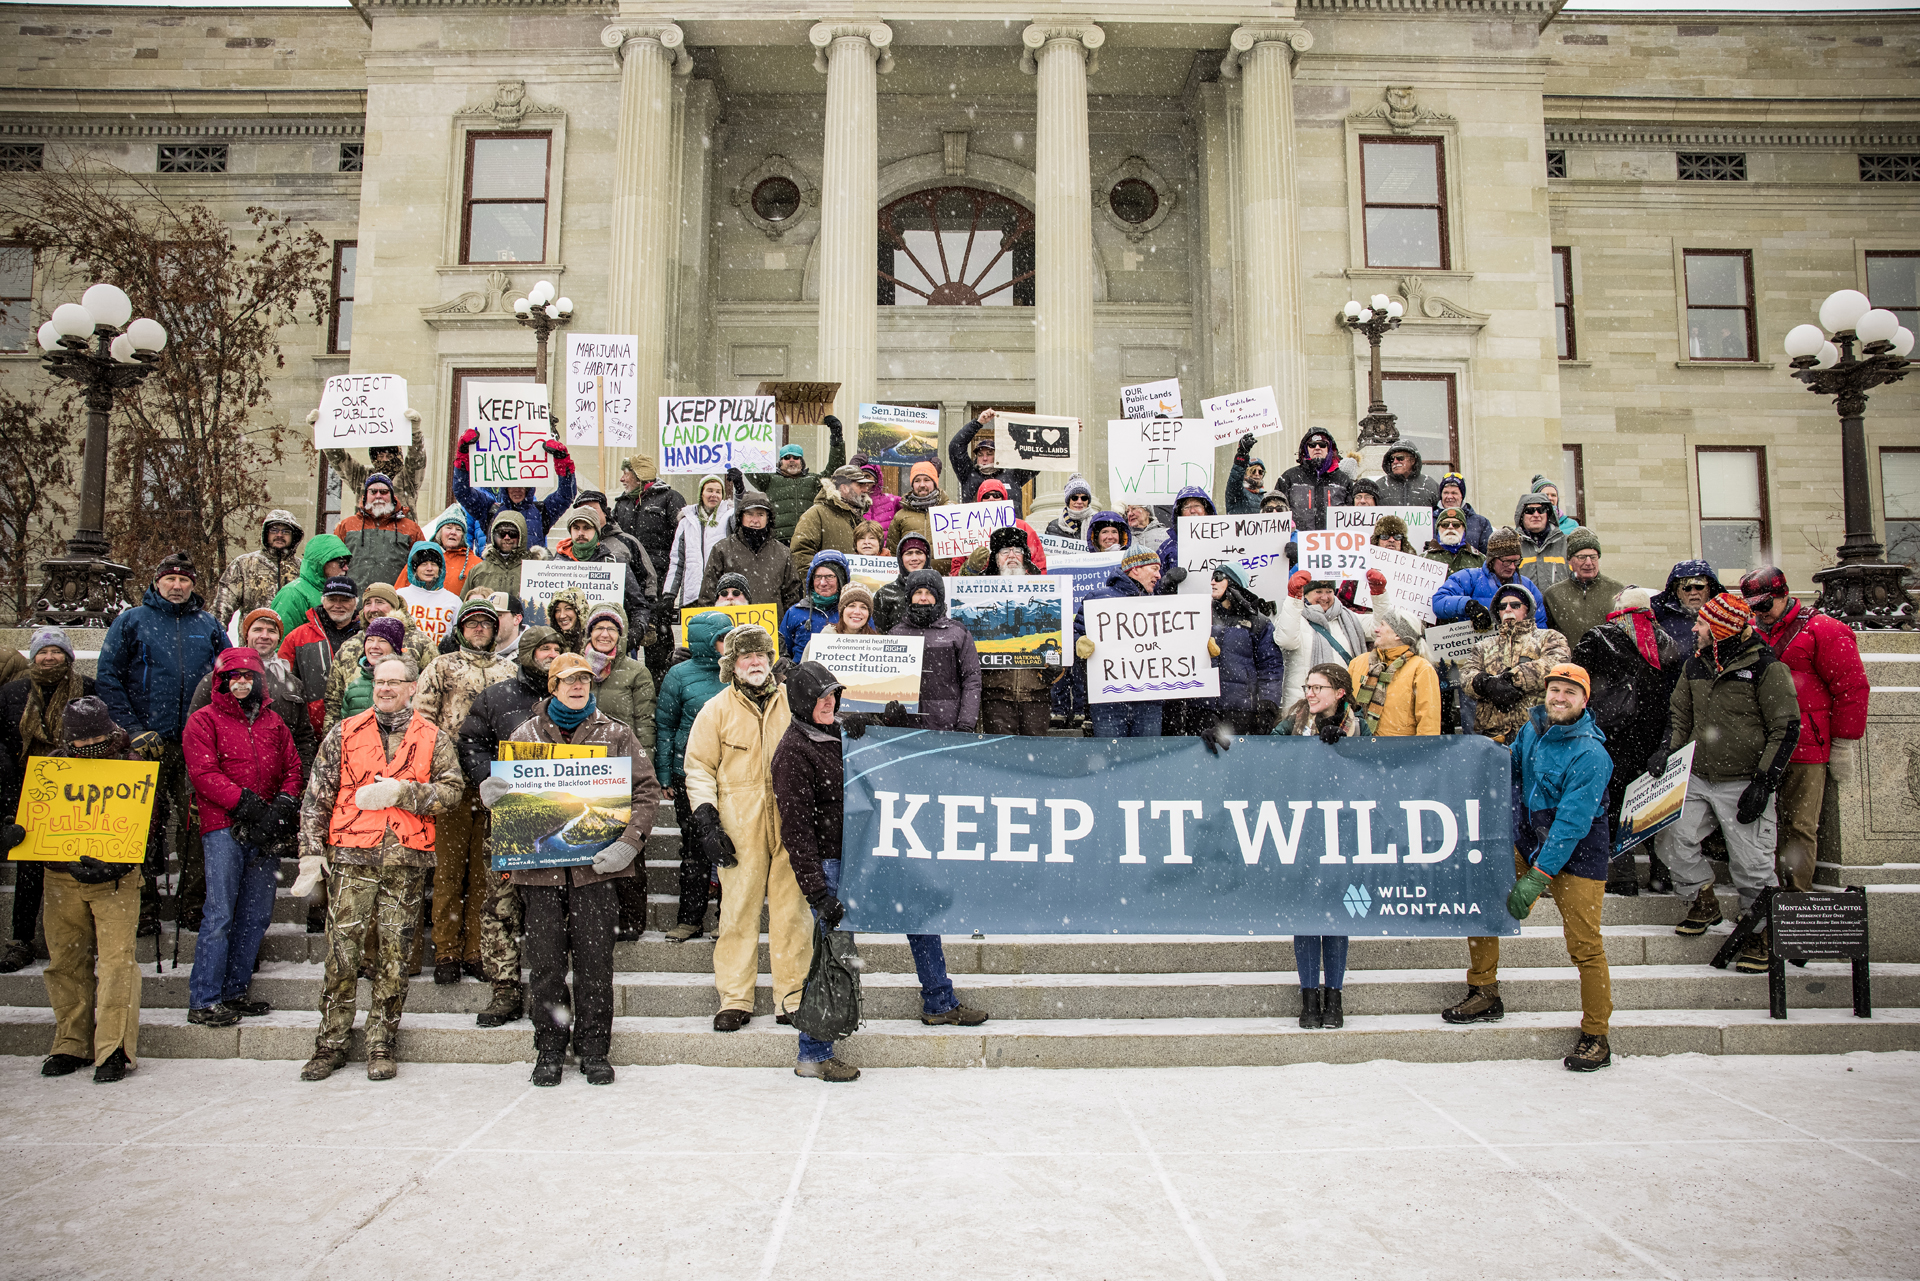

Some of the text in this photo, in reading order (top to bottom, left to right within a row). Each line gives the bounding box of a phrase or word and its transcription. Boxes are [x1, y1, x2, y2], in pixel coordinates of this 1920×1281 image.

[576, 342, 630, 358] MARIJUANA
[584, 362, 628, 377] HABITAT
[328, 376, 392, 392] PROTECT
[578, 380, 622, 394] UP IN
[1125, 387, 1142, 397] OUR
[342, 395, 368, 407] OUR
[1126, 391, 1172, 404] Public Lands
[332, 407, 384, 420] PUBLIC
[478, 395, 548, 422] KEEP THE
[666, 398, 776, 426] KEEP PUBLIC
[776, 402, 826, 424] NTANA
[872, 406, 928, 419] Sen. Daines:
[1128, 405, 1145, 414] OUR
[1129, 410, 1158, 419] Wildlife
[333, 418, 394, 438] LANDS!
[662, 424, 773, 448] LAND IN OUR
[1026, 428, 1037, 443] I
[1141, 421, 1182, 442] KEEP
[474, 425, 518, 452] LAST
[518, 423, 548, 480] BEST
[664, 442, 733, 470] HANDS!
[1148, 448, 1176, 462] IT
[474, 452, 518, 482] PLACE
[1115, 462, 1212, 494] WILD!
[933, 505, 1016, 532] DEMAND
[1394, 510, 1432, 526] ANDS
[1190, 519, 1291, 540] KEEP MONTANA
[1061, 540, 1090, 552] Daine
[1221, 545, 1246, 554] the
[1306, 532, 1366, 552] STOP
[860, 558, 899, 568] Daines
[1238, 554, 1280, 570] BEST
[1307, 554, 1366, 570] HB 372
[1412, 559, 1444, 576] LANDS
[1073, 571, 1100, 580] upport
[1393, 571, 1436, 590] HABITAT
[527, 579, 619, 590] Protect Montana's
[956, 584, 1055, 593] NATIONAL PARKS
[1073, 583, 1094, 591] kfoot
[1396, 588, 1432, 607] PEOPLE
[416, 619, 446, 634] AND
[1096, 610, 1200, 642] PROTECT
[1134, 642, 1161, 653] OUR
[1433, 638, 1472, 651] Protect
[815, 652, 916, 664] Protect Montana's
[980, 654, 1013, 665] CIER
[828, 664, 900, 673] constitution.
[513, 762, 612, 778] Sen. Daines:
[28, 759, 154, 816] Support
[1625, 787, 1649, 809] Protect
[1650, 764, 1687, 792] Montana's
[1631, 781, 1674, 813] constitution.
[26, 800, 129, 833] Public
[872, 790, 1483, 864] KEEP IT WILD!
[33, 823, 143, 858] Lands
[1378, 886, 1427, 898] WILD
[1380, 902, 1482, 916] MONTANA
